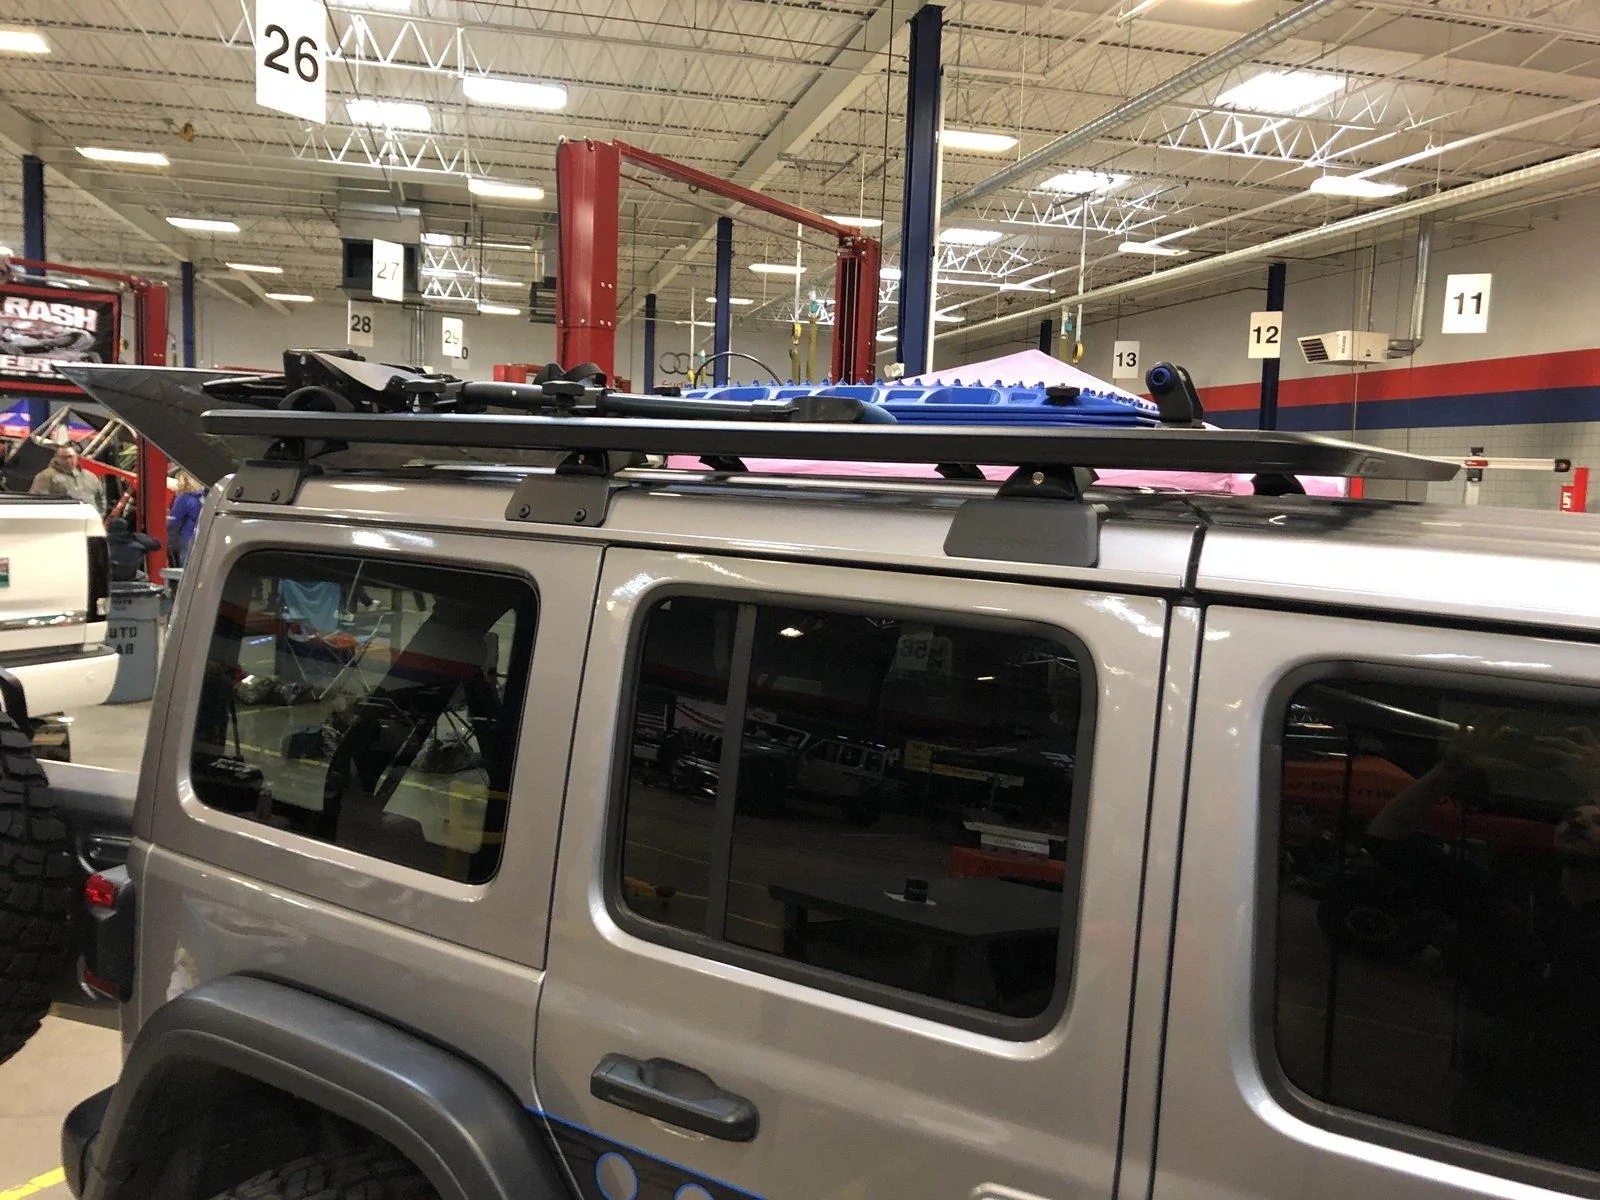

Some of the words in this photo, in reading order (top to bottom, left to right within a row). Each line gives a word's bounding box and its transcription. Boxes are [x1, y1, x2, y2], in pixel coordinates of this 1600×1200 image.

[263, 24, 319, 82] 26
[376, 260, 400, 280] 27
[1453, 292, 1483, 315] 11
[0, 297, 98, 332] RASH
[351, 314, 372, 333] 28
[1253, 326, 1279, 344] 12
[1116, 352, 1137, 367] 13
[109, 627, 137, 639] UTO
